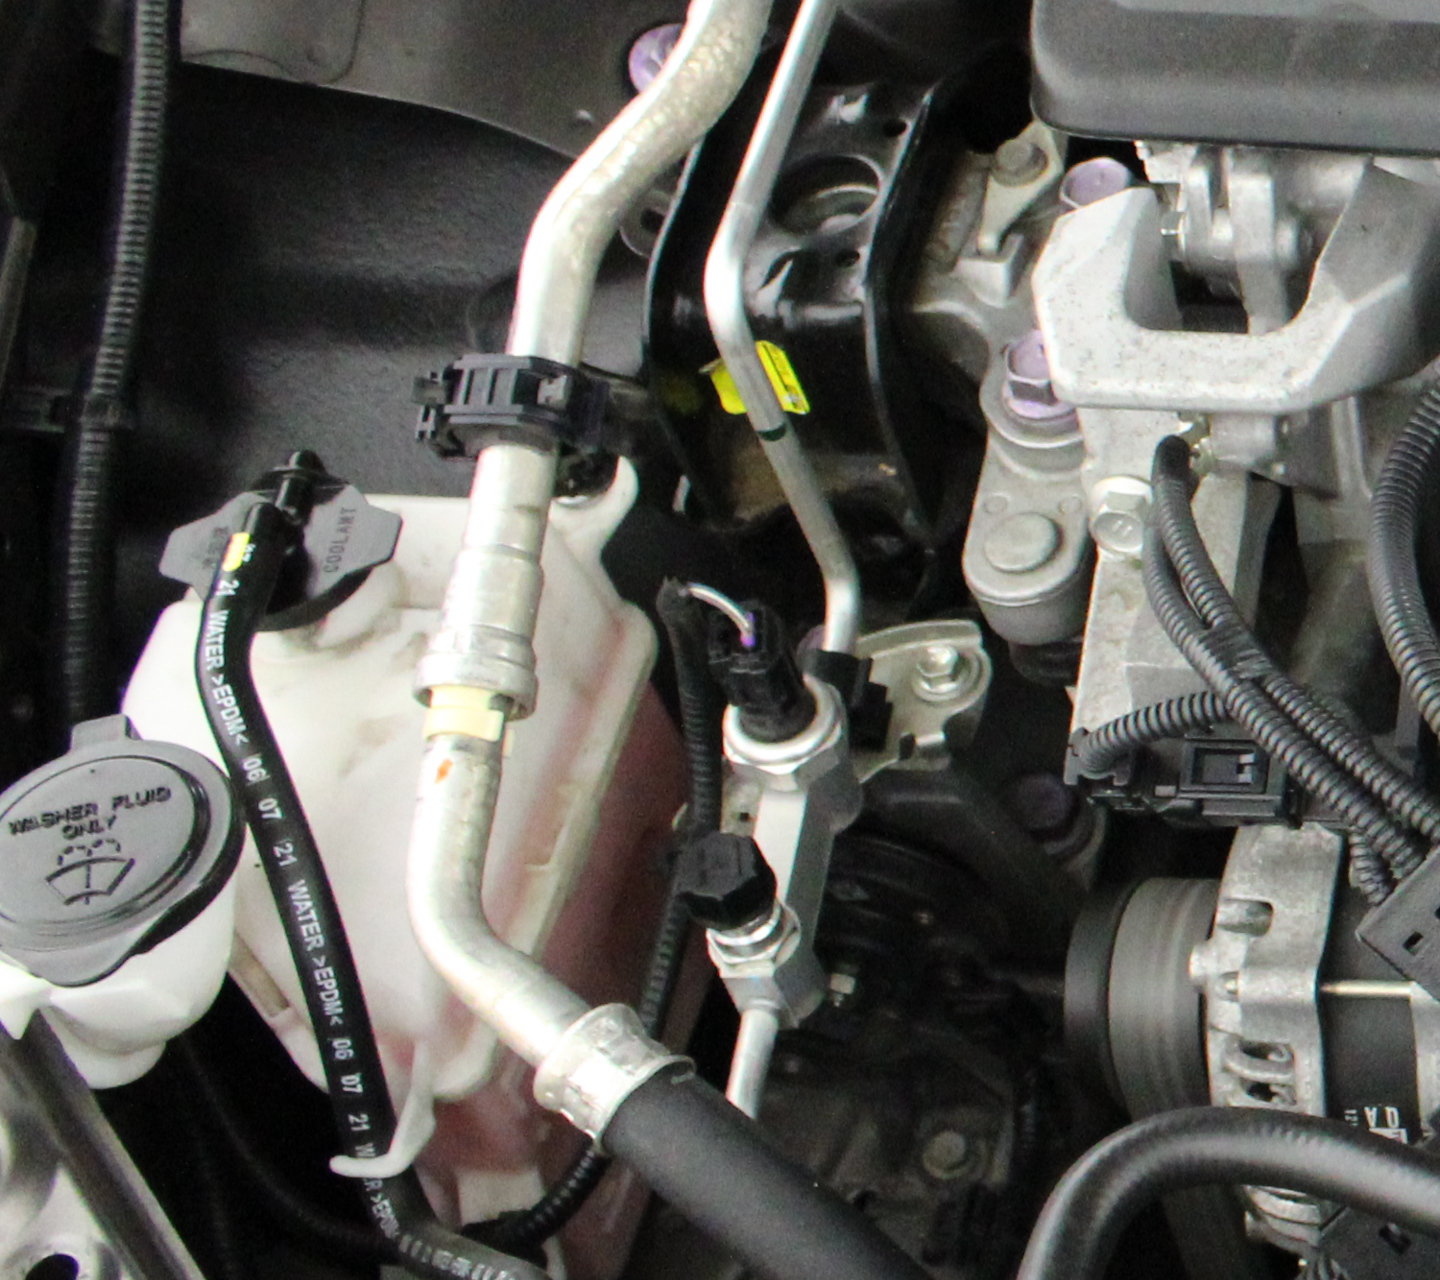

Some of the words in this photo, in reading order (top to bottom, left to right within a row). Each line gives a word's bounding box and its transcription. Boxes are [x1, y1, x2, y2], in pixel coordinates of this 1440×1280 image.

[325, 507, 357, 573] COOLANT
[205, 610, 229, 671] WATER
[258, 797, 283, 821] 07
[9, 803, 99, 835] WASHER
[112, 787, 172, 811] FLUID
[62, 815, 117, 840] ONLY
[273, 841, 298, 867] 21
[288, 880, 325, 951] WATER
[348, 1113, 370, 1132] 21
